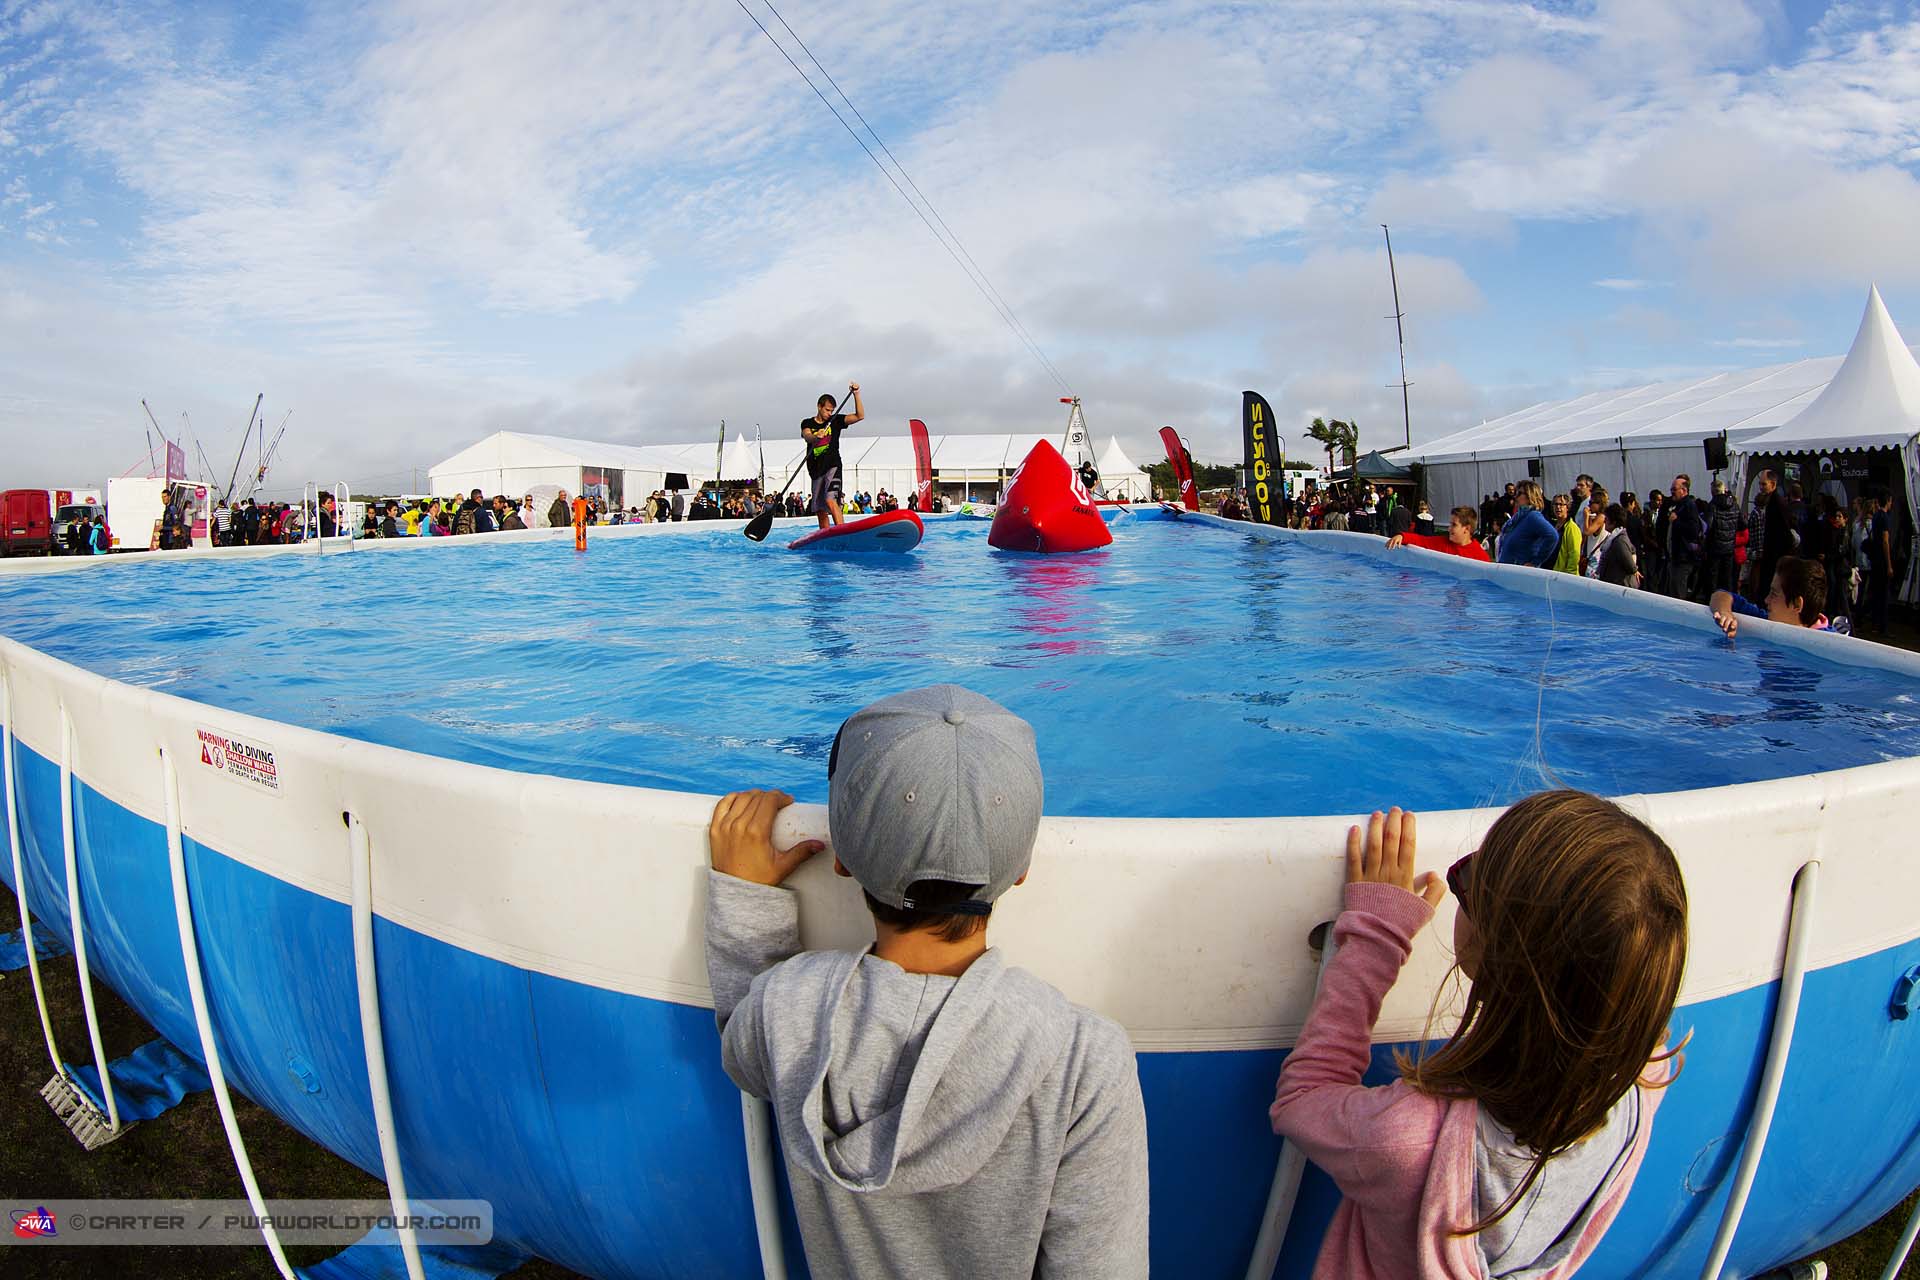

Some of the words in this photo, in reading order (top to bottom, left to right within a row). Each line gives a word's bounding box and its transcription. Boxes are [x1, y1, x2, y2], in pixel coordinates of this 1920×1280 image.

[197, 729, 230, 750] WARNING
[232, 740, 243, 754] NO
[245, 745, 274, 764] DIVING
[226, 751, 253, 767] SHALLOW
[253, 760, 275, 774] WATER
